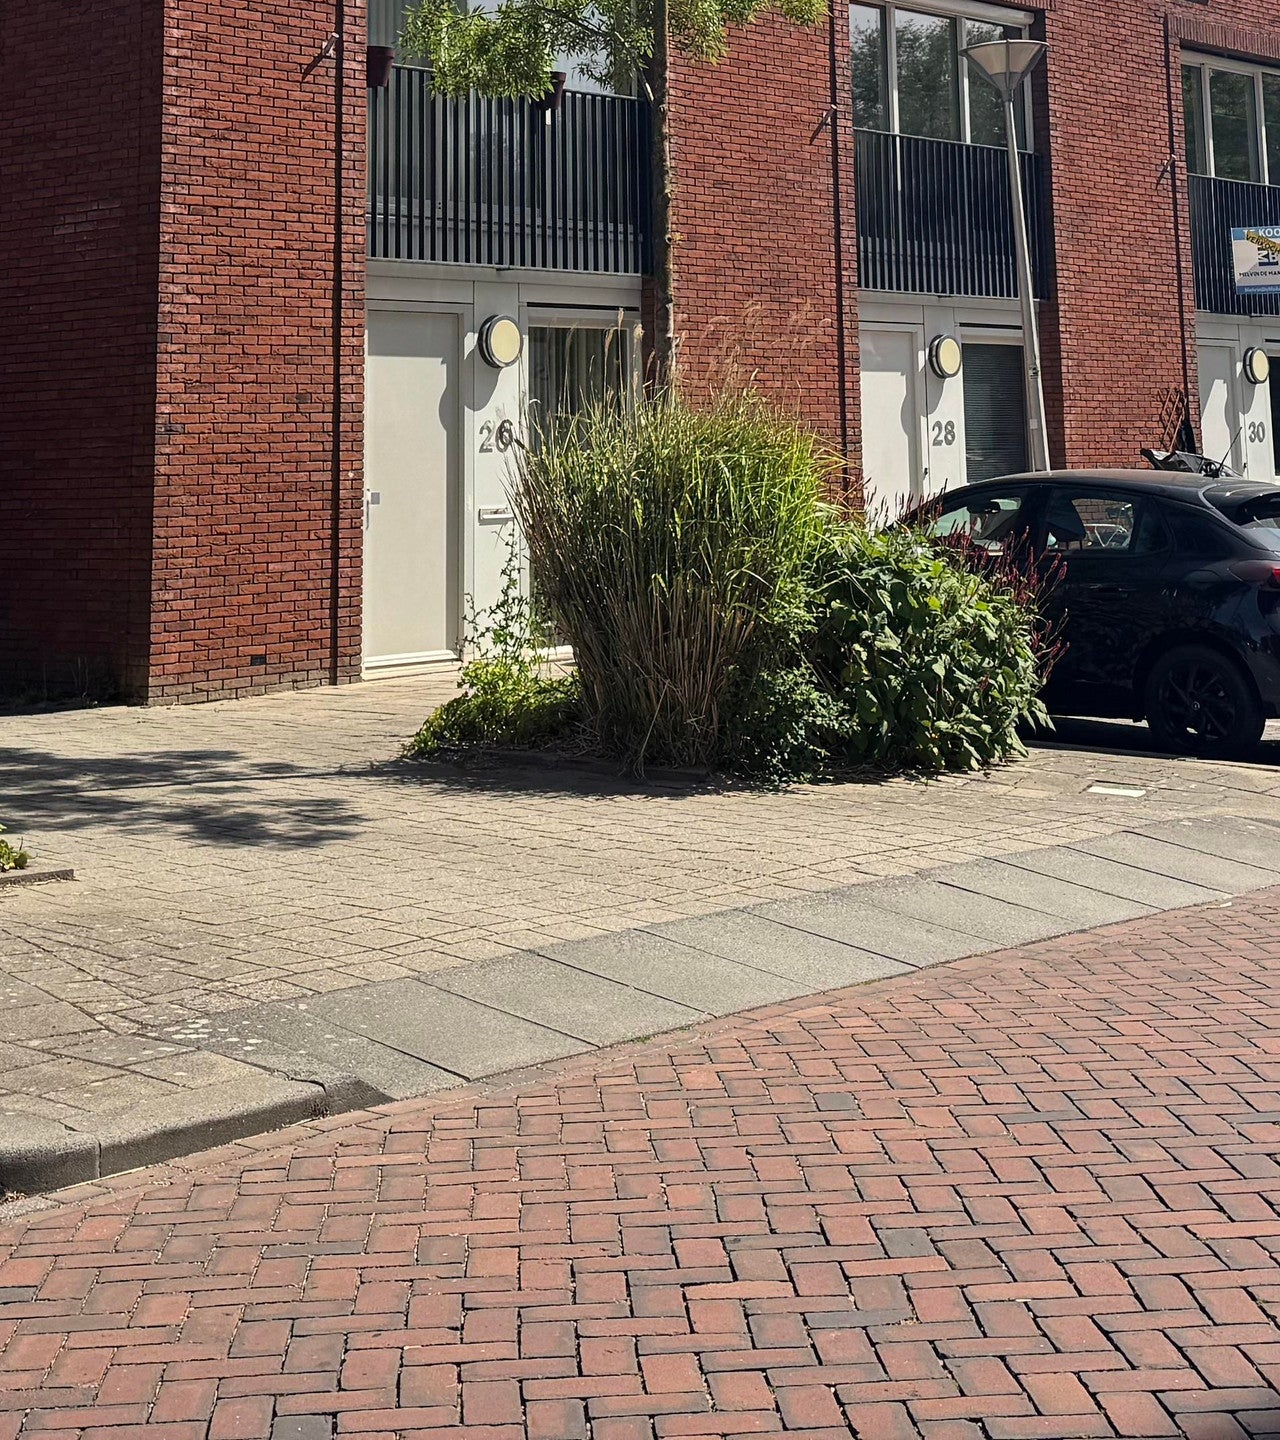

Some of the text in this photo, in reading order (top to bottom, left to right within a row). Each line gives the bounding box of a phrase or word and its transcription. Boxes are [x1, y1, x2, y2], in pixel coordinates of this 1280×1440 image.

[479, 419, 513, 453] 26
[932, 420, 956, 447] 28
[1248, 421, 1265, 443] 30
